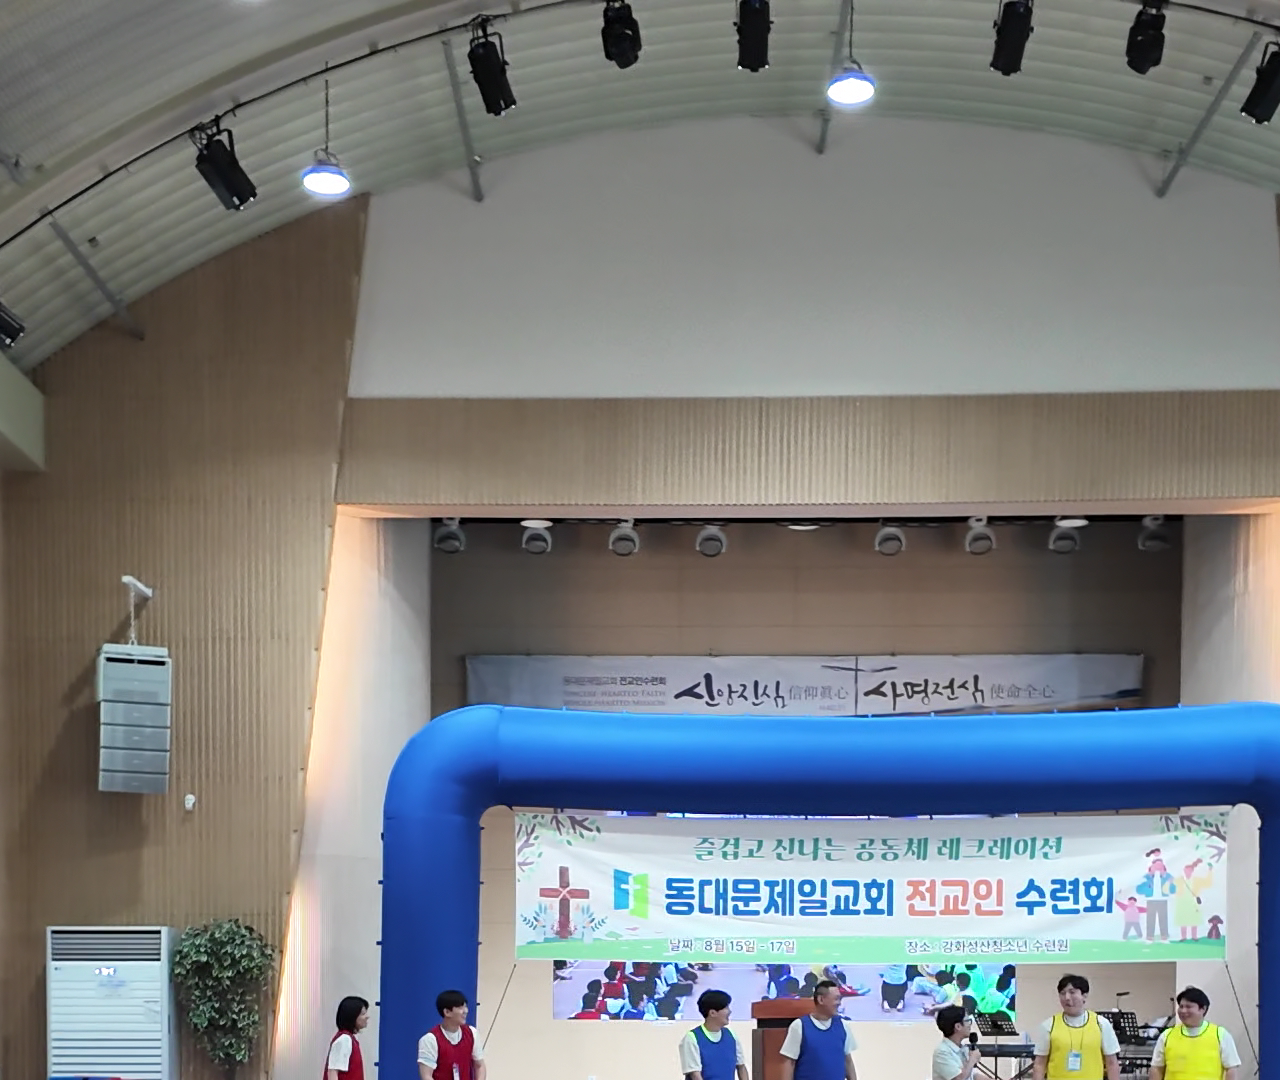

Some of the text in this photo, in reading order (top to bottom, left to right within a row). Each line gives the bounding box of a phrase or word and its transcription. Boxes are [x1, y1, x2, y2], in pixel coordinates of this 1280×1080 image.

[693, 836, 1064, 862] 즐겁고 신나는 공동체 레크레이션
[665, 876, 1114, 918] 동대문제일교회 전교인 수련회
[669, 939, 693, 952] 날짜
[704, 940, 725, 953] 8월
[729, 940, 755, 953] 15일
[769, 940, 795, 954] 17일
[906, 940, 931, 953] 장소
